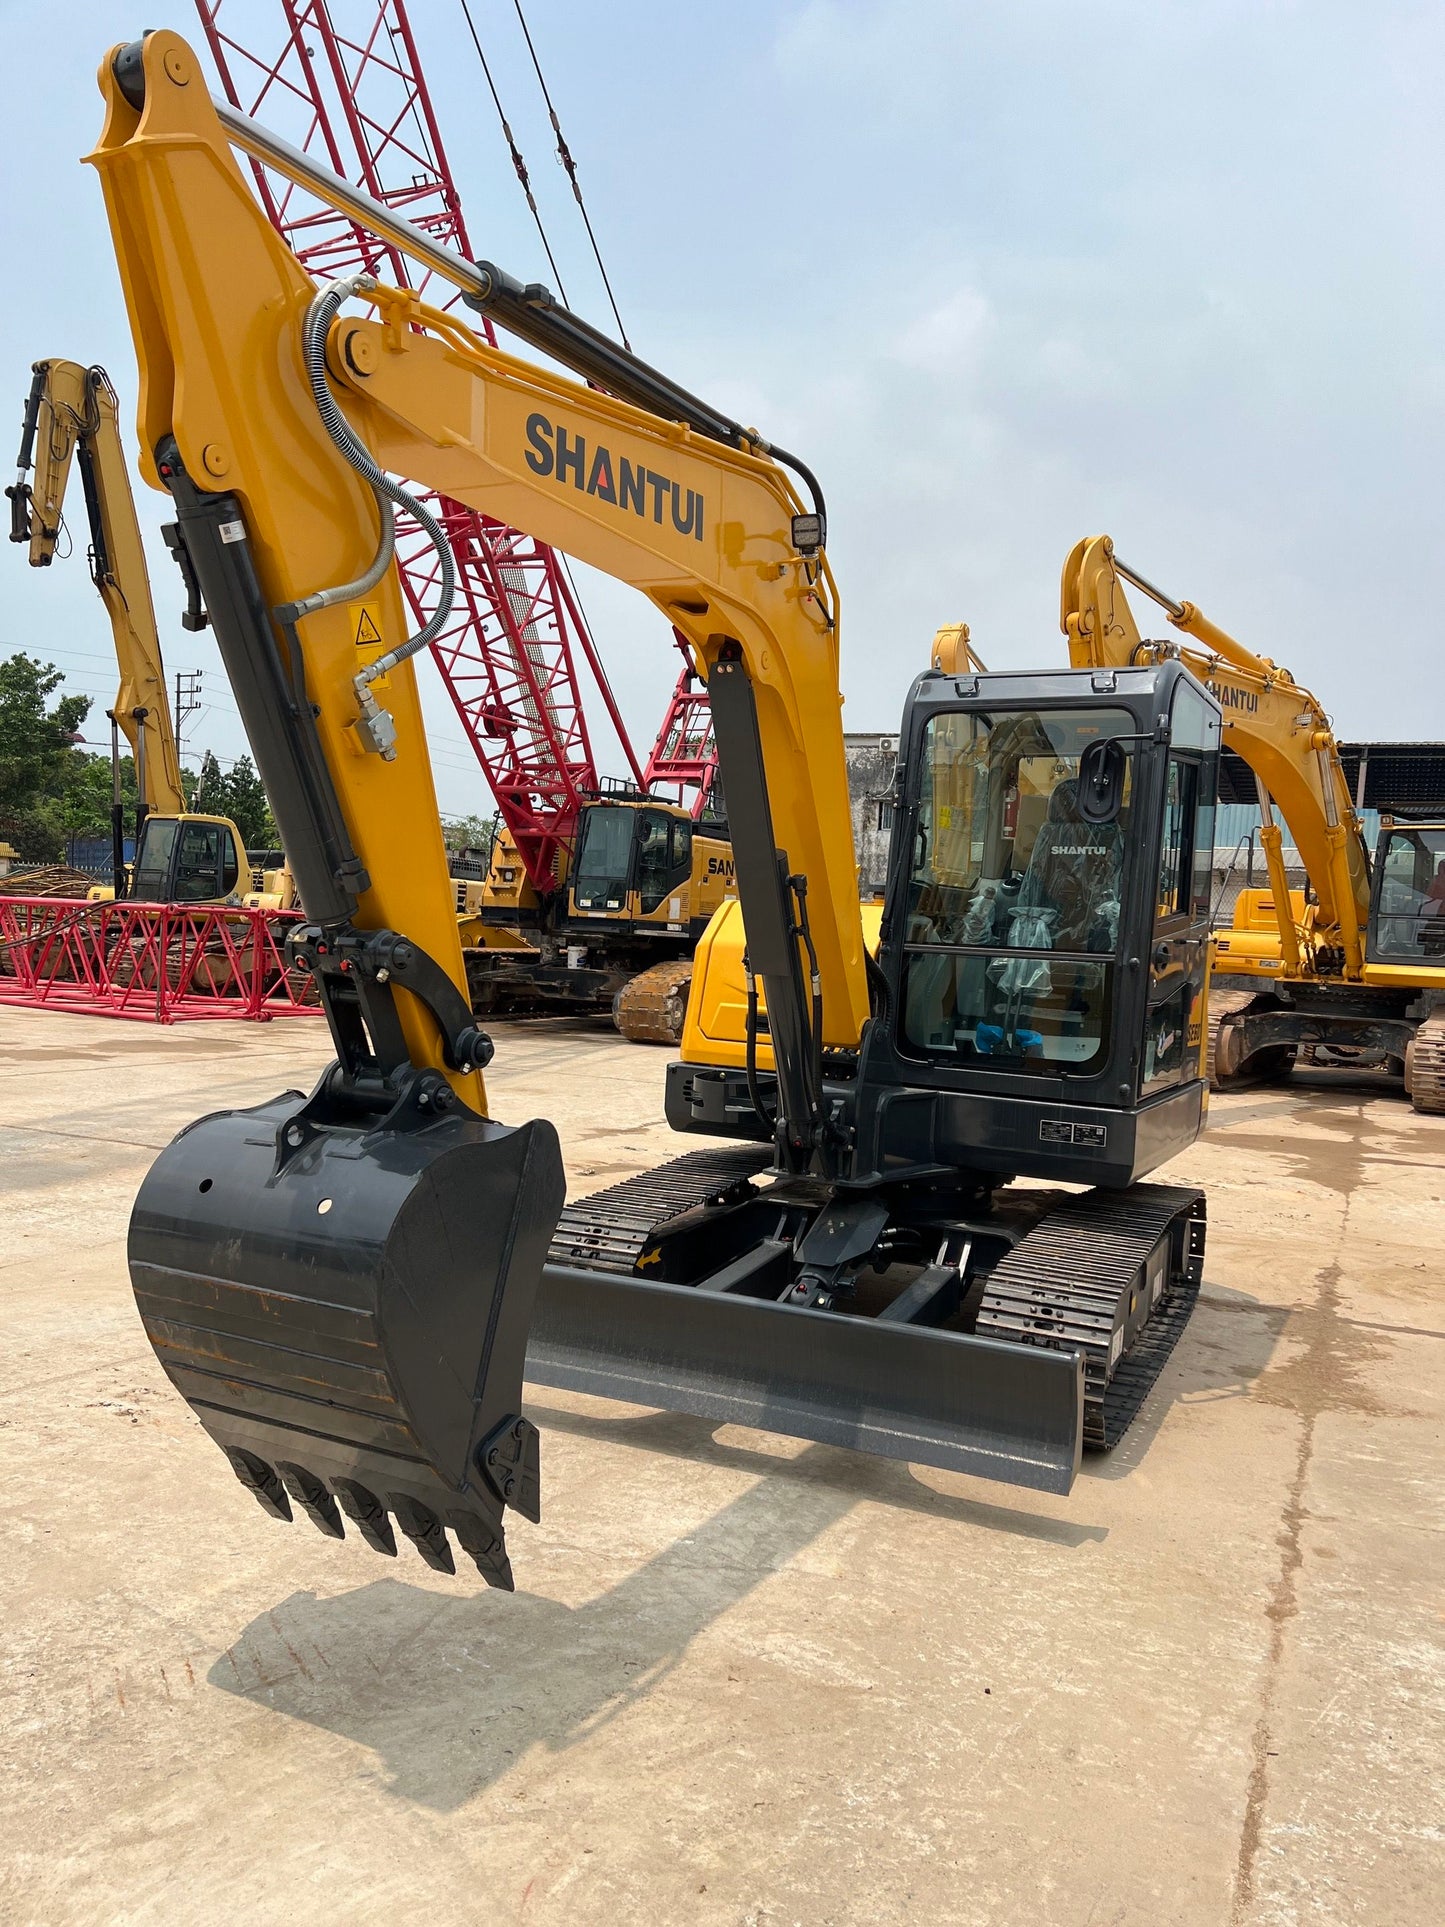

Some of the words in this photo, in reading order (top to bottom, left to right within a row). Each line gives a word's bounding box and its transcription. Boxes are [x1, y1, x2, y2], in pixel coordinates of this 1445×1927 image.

[524, 412, 704, 542] SHANTUI
[1051, 846, 1106, 855] SHANTUI
[708, 857, 735, 877] SAN
